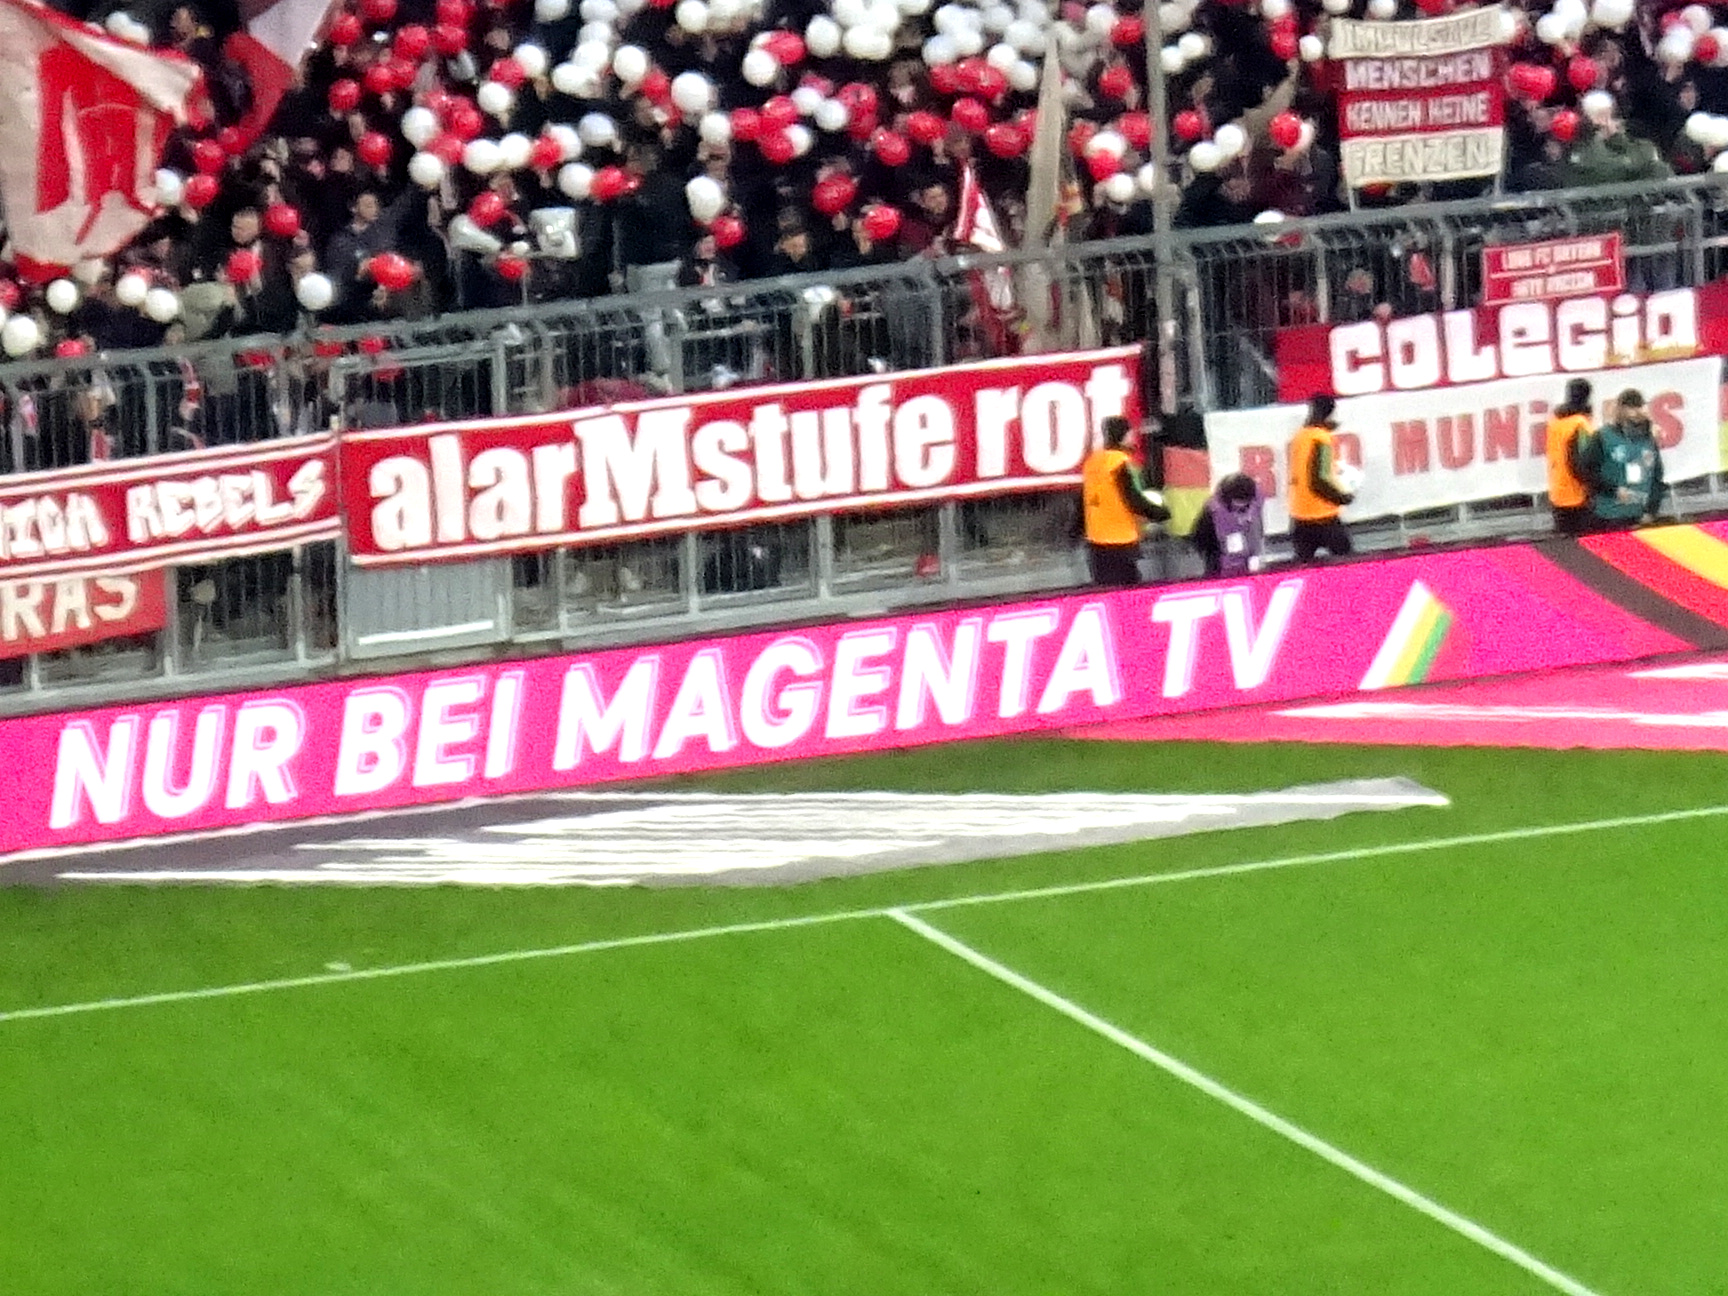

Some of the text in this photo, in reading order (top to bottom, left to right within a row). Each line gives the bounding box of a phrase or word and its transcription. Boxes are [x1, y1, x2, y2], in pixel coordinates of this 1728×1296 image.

[1344, 49, 1492, 91] MENSCHEN
[126, 459, 326, 544] REBELS
[369, 363, 1130, 551] alarMstufe rot
[46, 576, 1302, 832] NUR BEI MAGENTA TV
